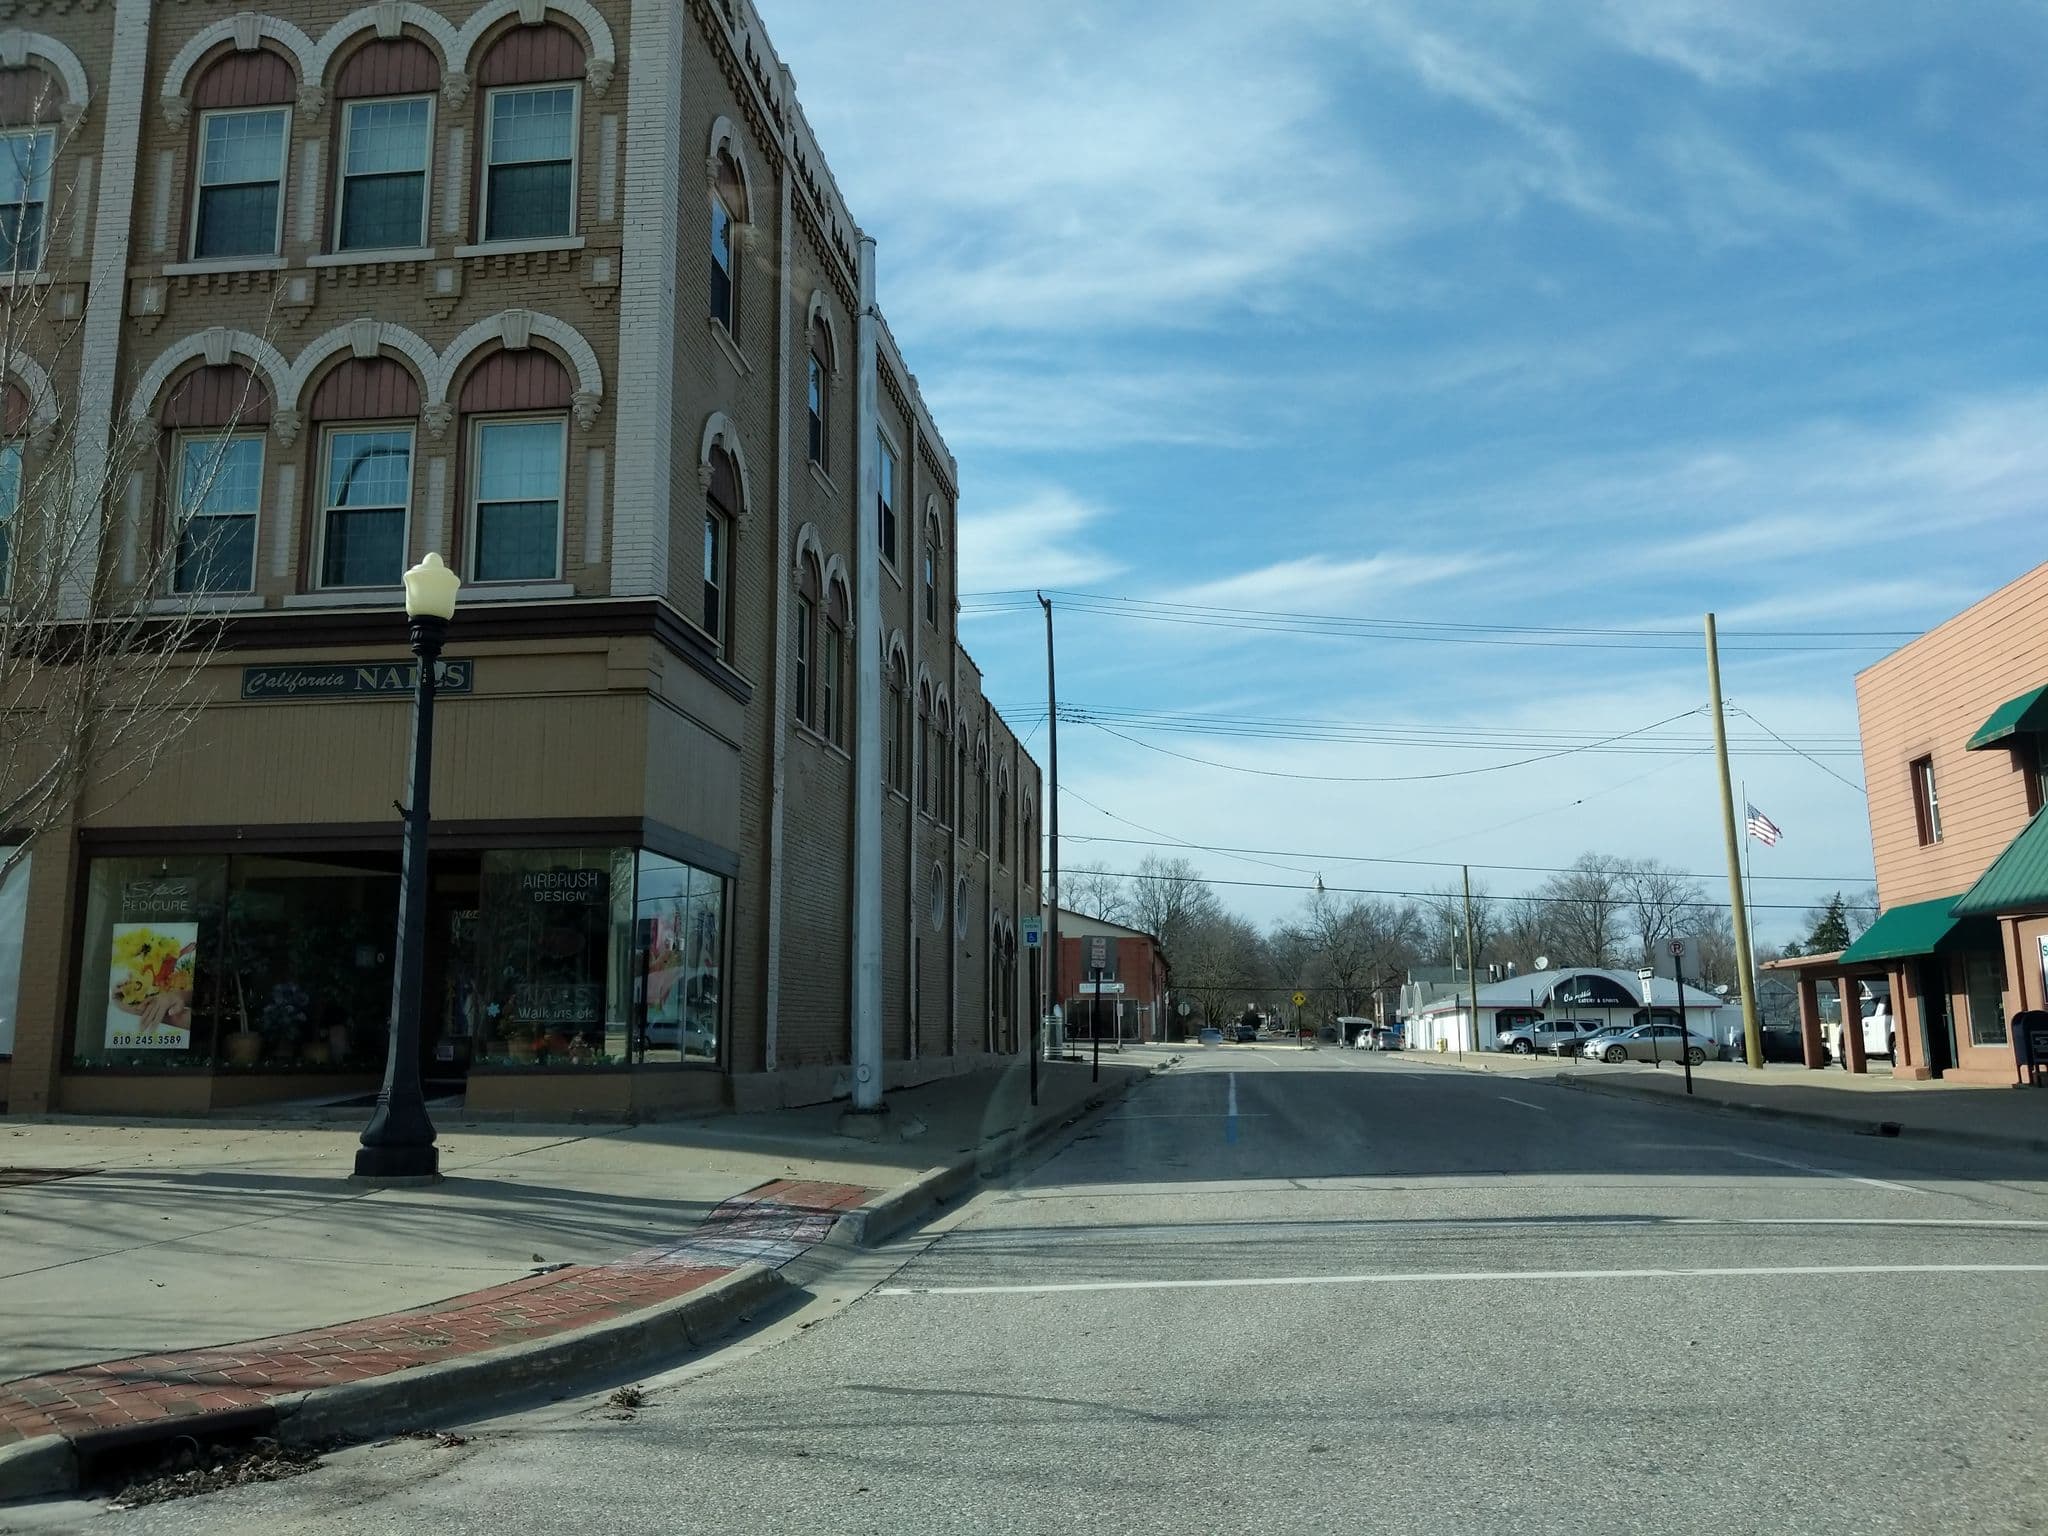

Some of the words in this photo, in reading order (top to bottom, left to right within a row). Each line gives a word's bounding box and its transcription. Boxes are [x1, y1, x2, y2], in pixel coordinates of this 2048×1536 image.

[246, 672, 344, 694] California
[353, 665, 465, 690] NAIS
[522, 872, 598, 889] AIRBRUSH
[533, 890, 586, 903] DESIGN
[122, 901, 188, 912] PEDICURE
[518, 1007, 550, 1020] Walk
[553, 1008, 572, 1019] ins
[112, 1036, 131, 1045] 810
[135, 1036, 153, 1045] 245
[158, 1035, 182, 1045] 3589
